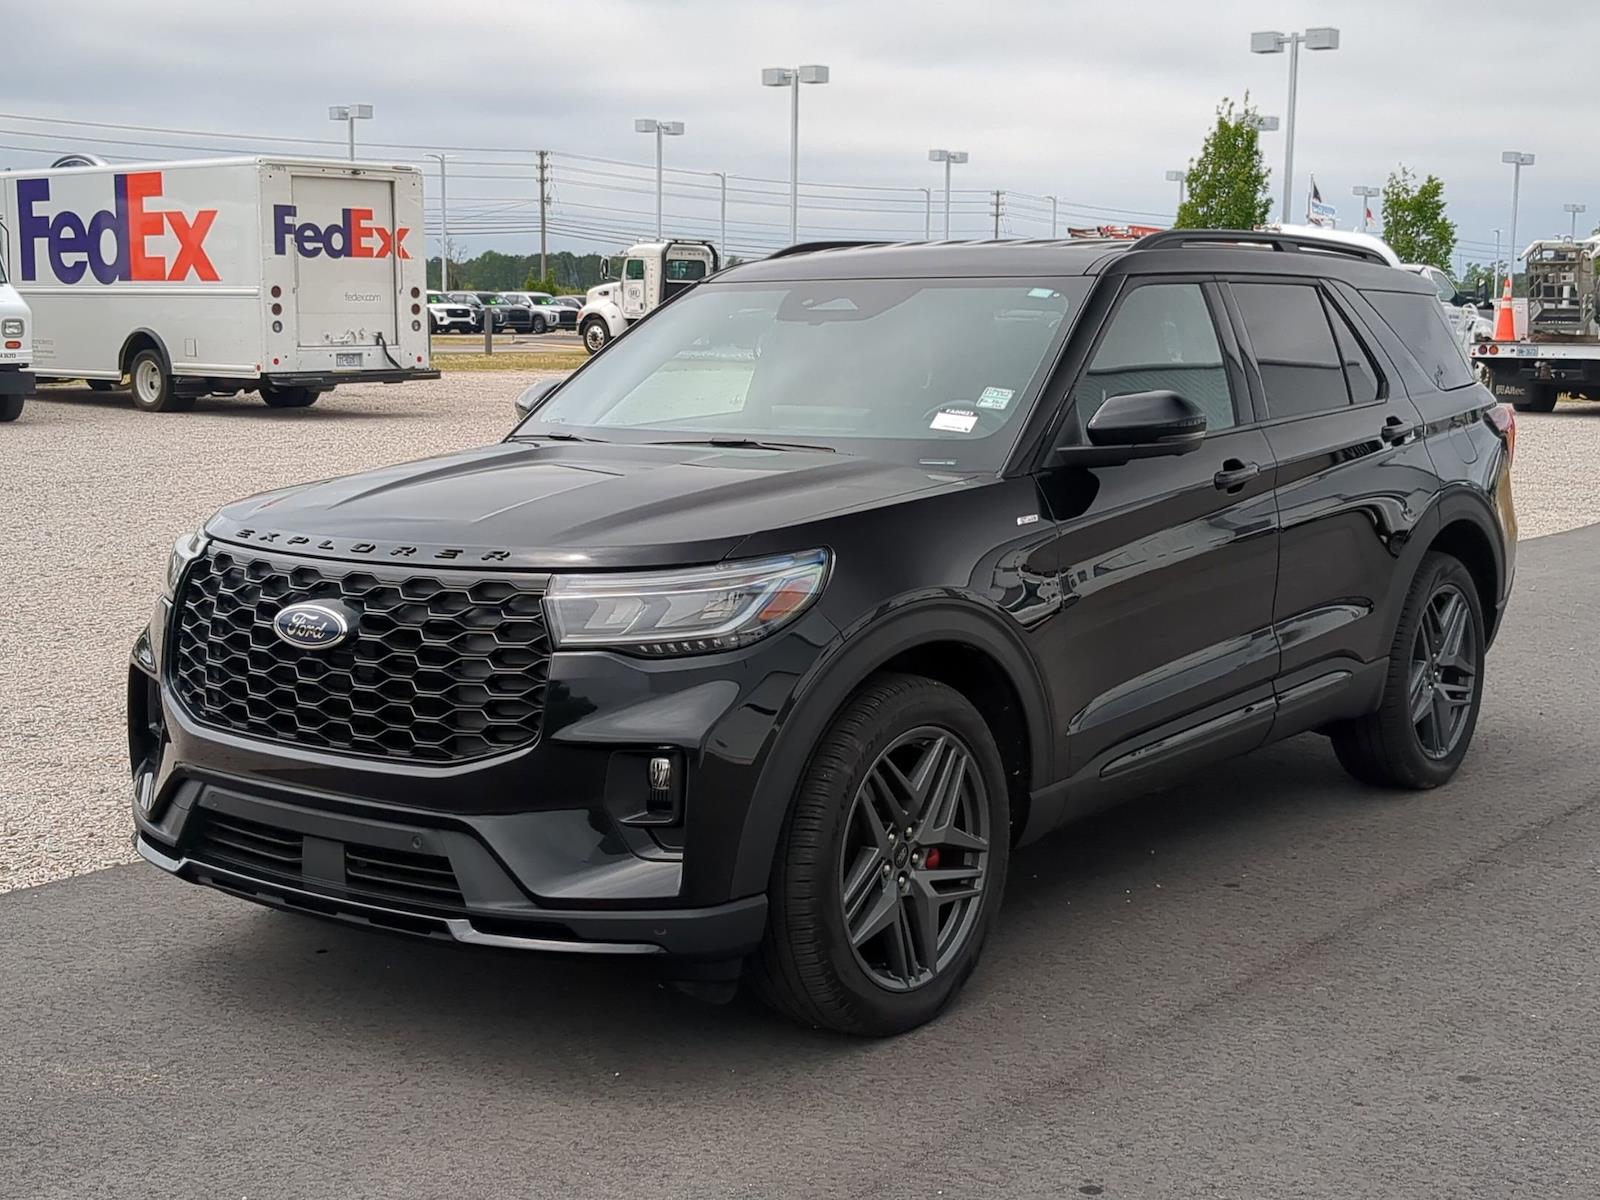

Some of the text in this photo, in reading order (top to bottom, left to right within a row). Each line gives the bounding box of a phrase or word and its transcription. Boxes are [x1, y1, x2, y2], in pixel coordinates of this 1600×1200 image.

[16, 171, 221, 285] FedEx
[273, 204, 411, 259] FedEx
[236, 528, 511, 562] EXPLORER
[287, 612, 328, 639] Ford
